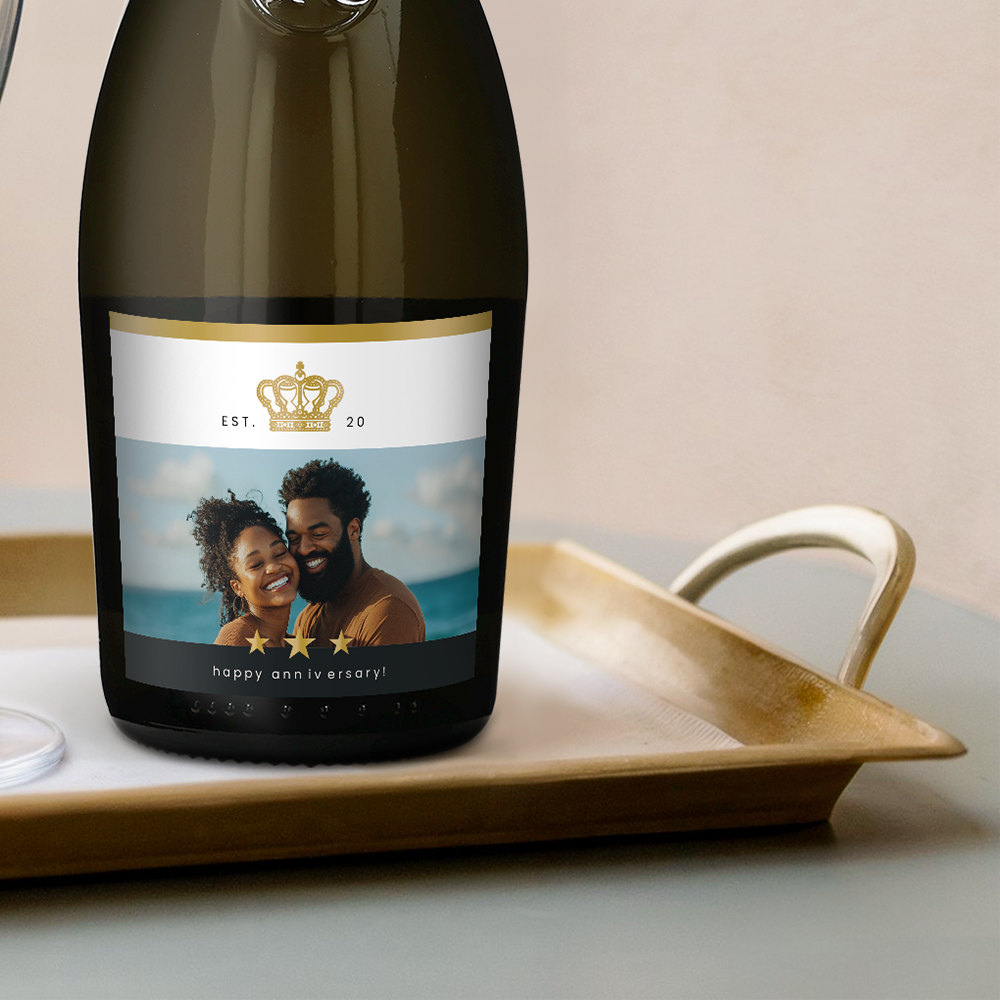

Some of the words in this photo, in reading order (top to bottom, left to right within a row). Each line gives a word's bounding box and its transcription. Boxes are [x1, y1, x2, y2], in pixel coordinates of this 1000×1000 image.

[221, 415, 256, 428] EST.
[346, 416, 365, 428] 20
[212, 665, 263, 682] happy
